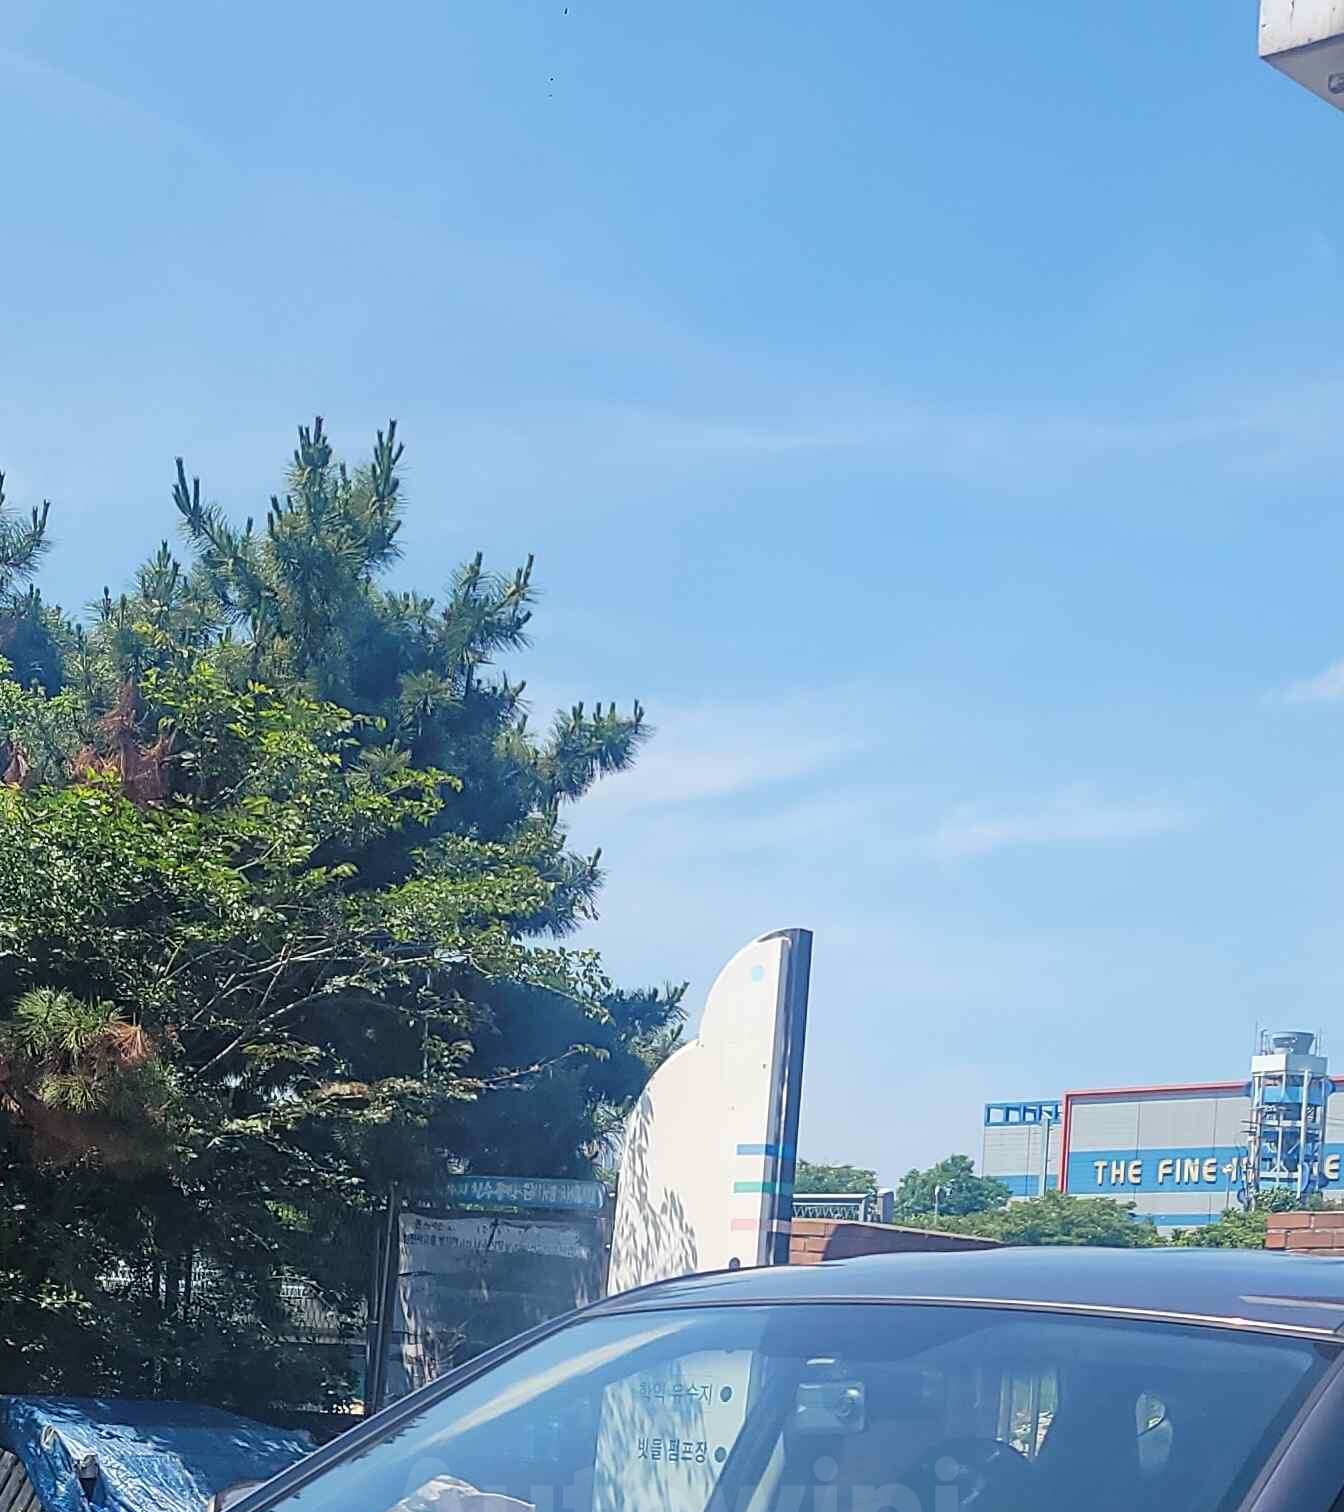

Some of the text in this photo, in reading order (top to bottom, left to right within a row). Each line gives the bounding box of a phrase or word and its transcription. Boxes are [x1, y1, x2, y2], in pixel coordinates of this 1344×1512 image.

[1094, 1159, 1142, 1186] THE
[1158, 1157, 1218, 1186] FINE
[637, 1437, 709, 1464] 빗물 펌프장
